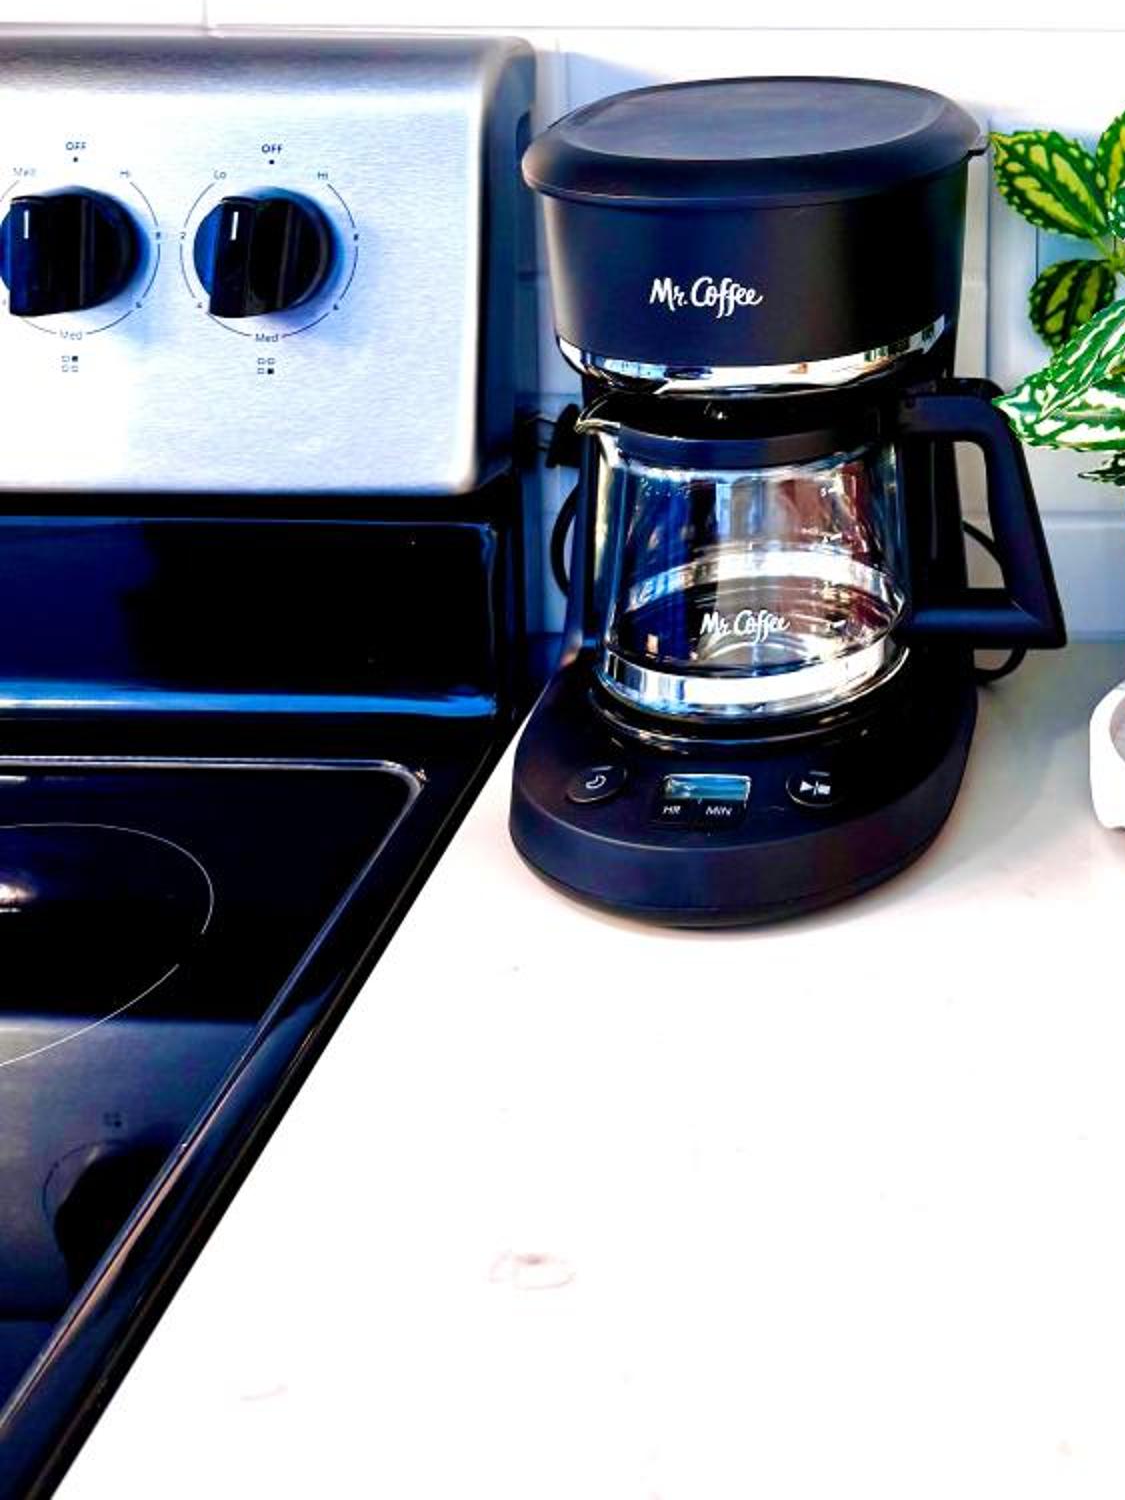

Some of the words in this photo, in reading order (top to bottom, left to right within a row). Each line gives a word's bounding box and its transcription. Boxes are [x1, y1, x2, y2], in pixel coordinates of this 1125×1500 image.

[65, 141, 87, 151] OFF
[261, 143, 285, 154] OFF
[649, 277, 688, 312] Mr.
[691, 276, 763, 318] Coffee
[255, 333, 279, 343] Med
[733, 609, 790, 644] Coffee
[662, 805, 681, 815] HR
[705, 804, 733, 816] MIN
